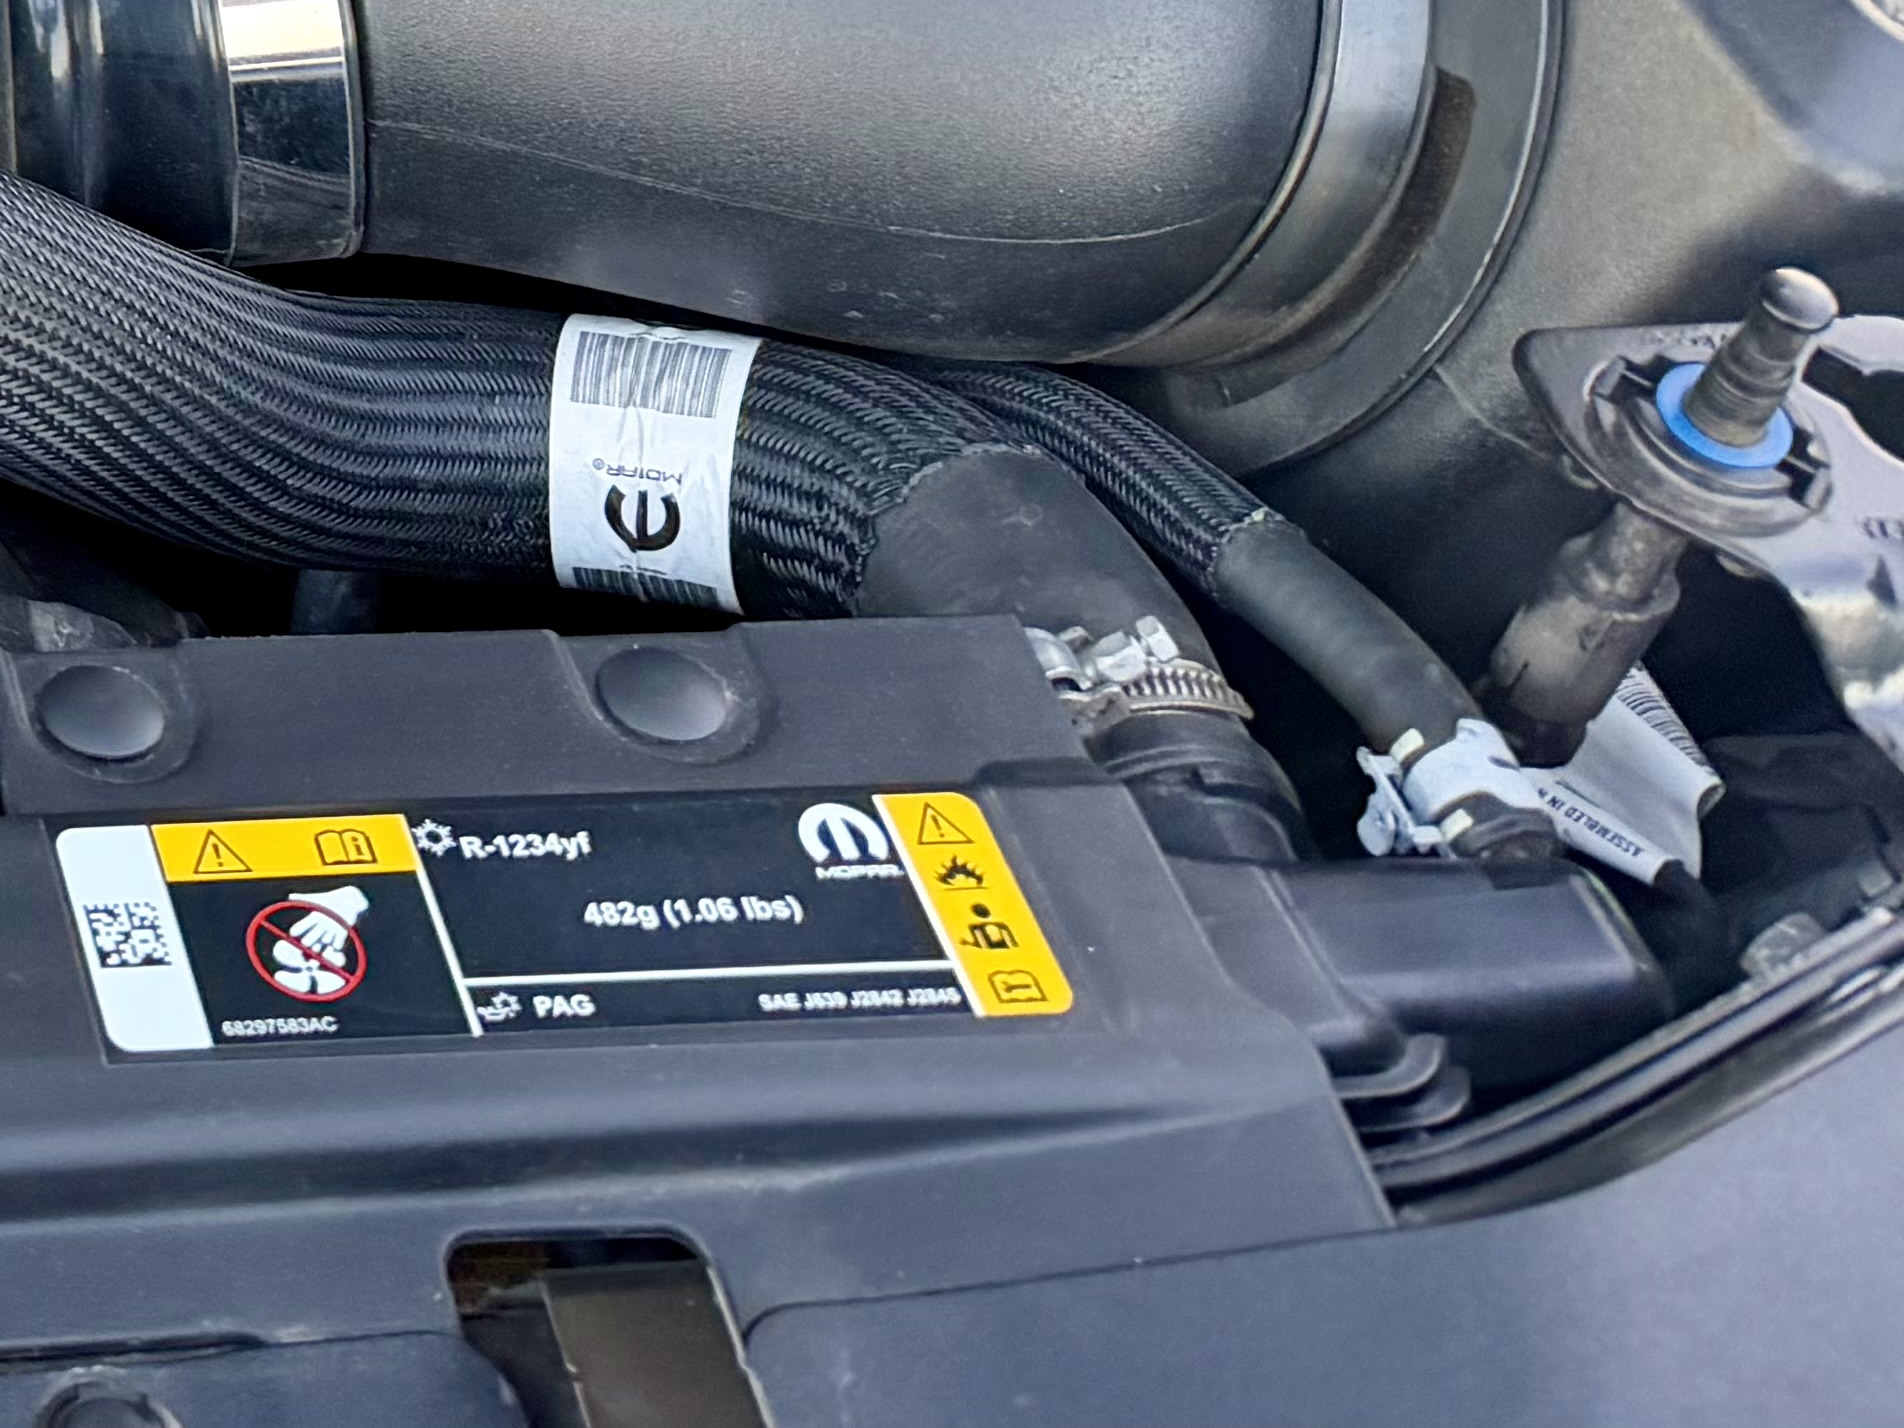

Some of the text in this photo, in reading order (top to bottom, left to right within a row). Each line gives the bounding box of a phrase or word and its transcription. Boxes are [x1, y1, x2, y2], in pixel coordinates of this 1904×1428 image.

[459, 829, 590, 861] R-1234yf
[1564, 806, 1644, 857] ASSEMBLED
[583, 894, 804, 930] 482g (1.06 lbs)
[533, 994, 596, 1020] PAG
[758, 992, 802, 1012] SAE
